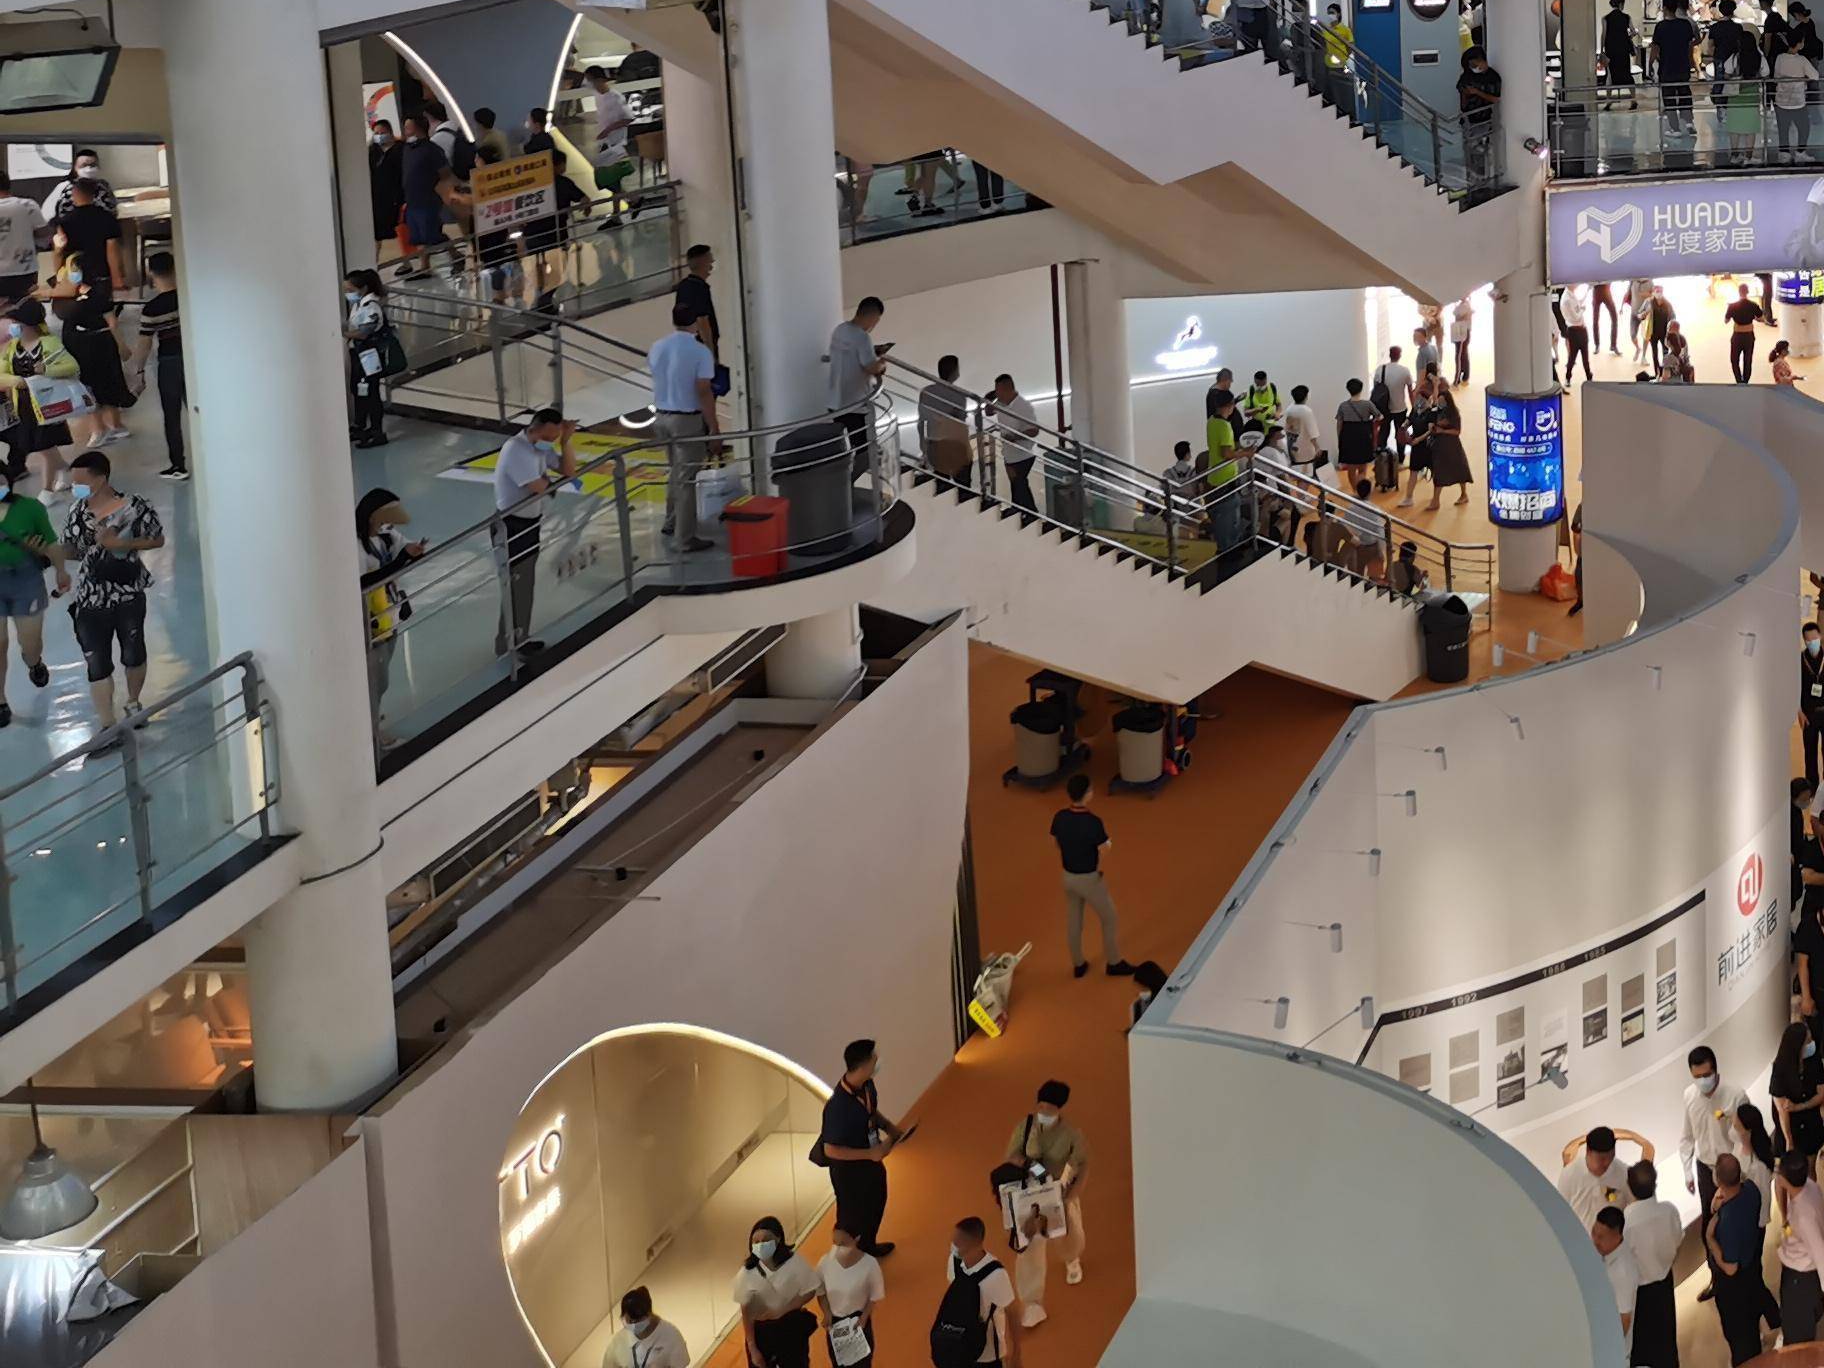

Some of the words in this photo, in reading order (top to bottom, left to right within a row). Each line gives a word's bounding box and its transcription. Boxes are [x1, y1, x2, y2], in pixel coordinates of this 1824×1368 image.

[1654, 200, 1753, 231] HUADU
[1652, 227, 1754, 257] 华度家居
[1717, 897, 1778, 988] 前进家居
